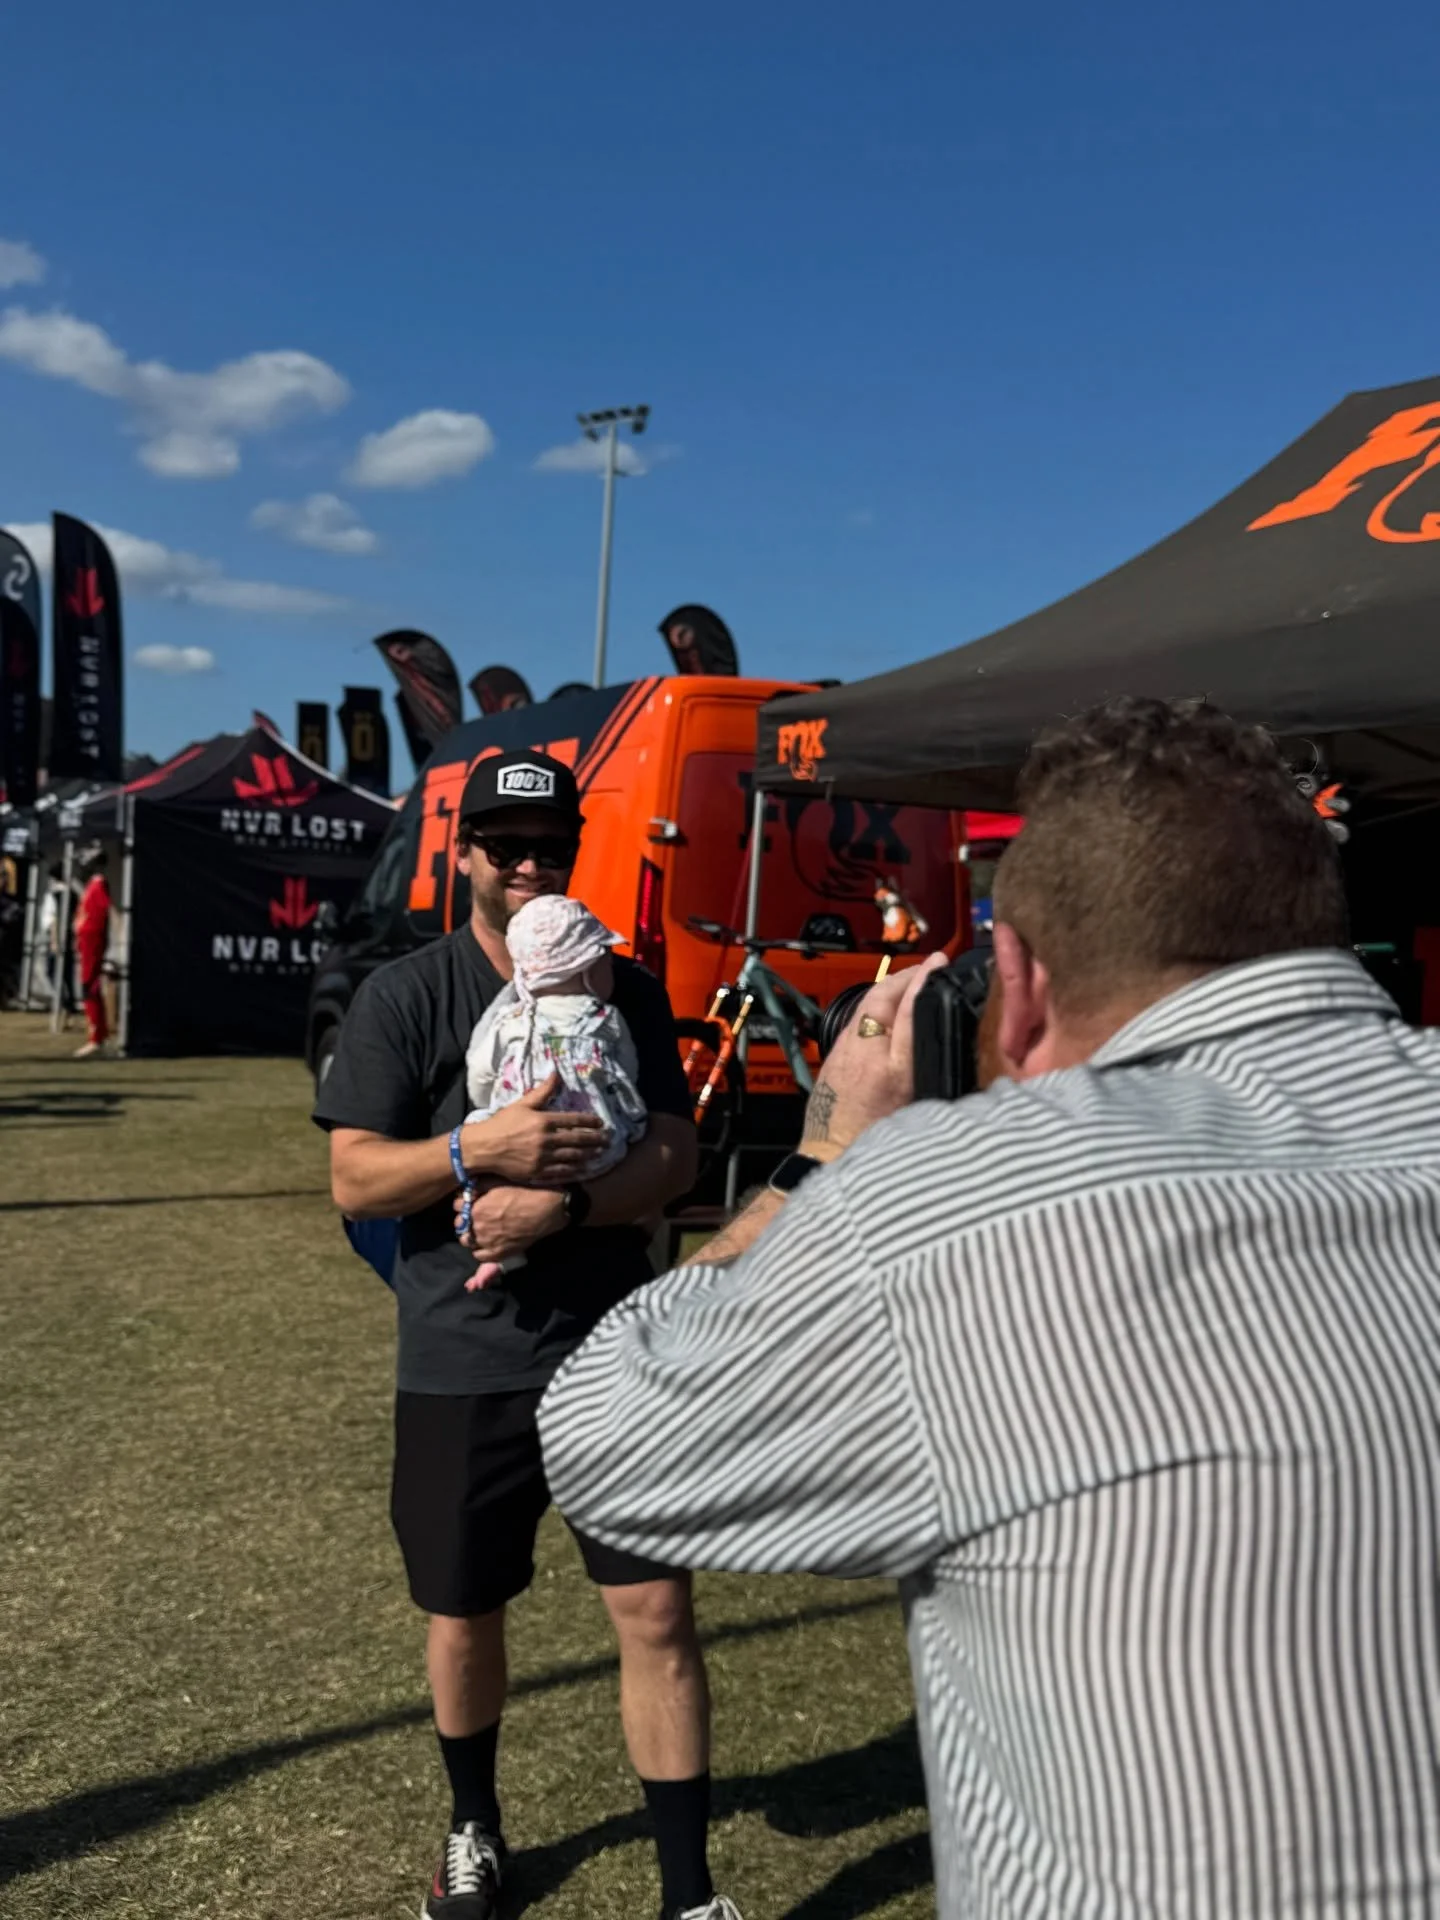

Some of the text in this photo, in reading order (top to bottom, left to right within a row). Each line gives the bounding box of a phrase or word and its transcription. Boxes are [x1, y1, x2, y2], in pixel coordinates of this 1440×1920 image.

[778, 718, 829, 780] FOX
[505, 771, 548, 793] 100%
[221, 808, 365, 842] NVR LOST
[212, 935, 280, 962] NVR
